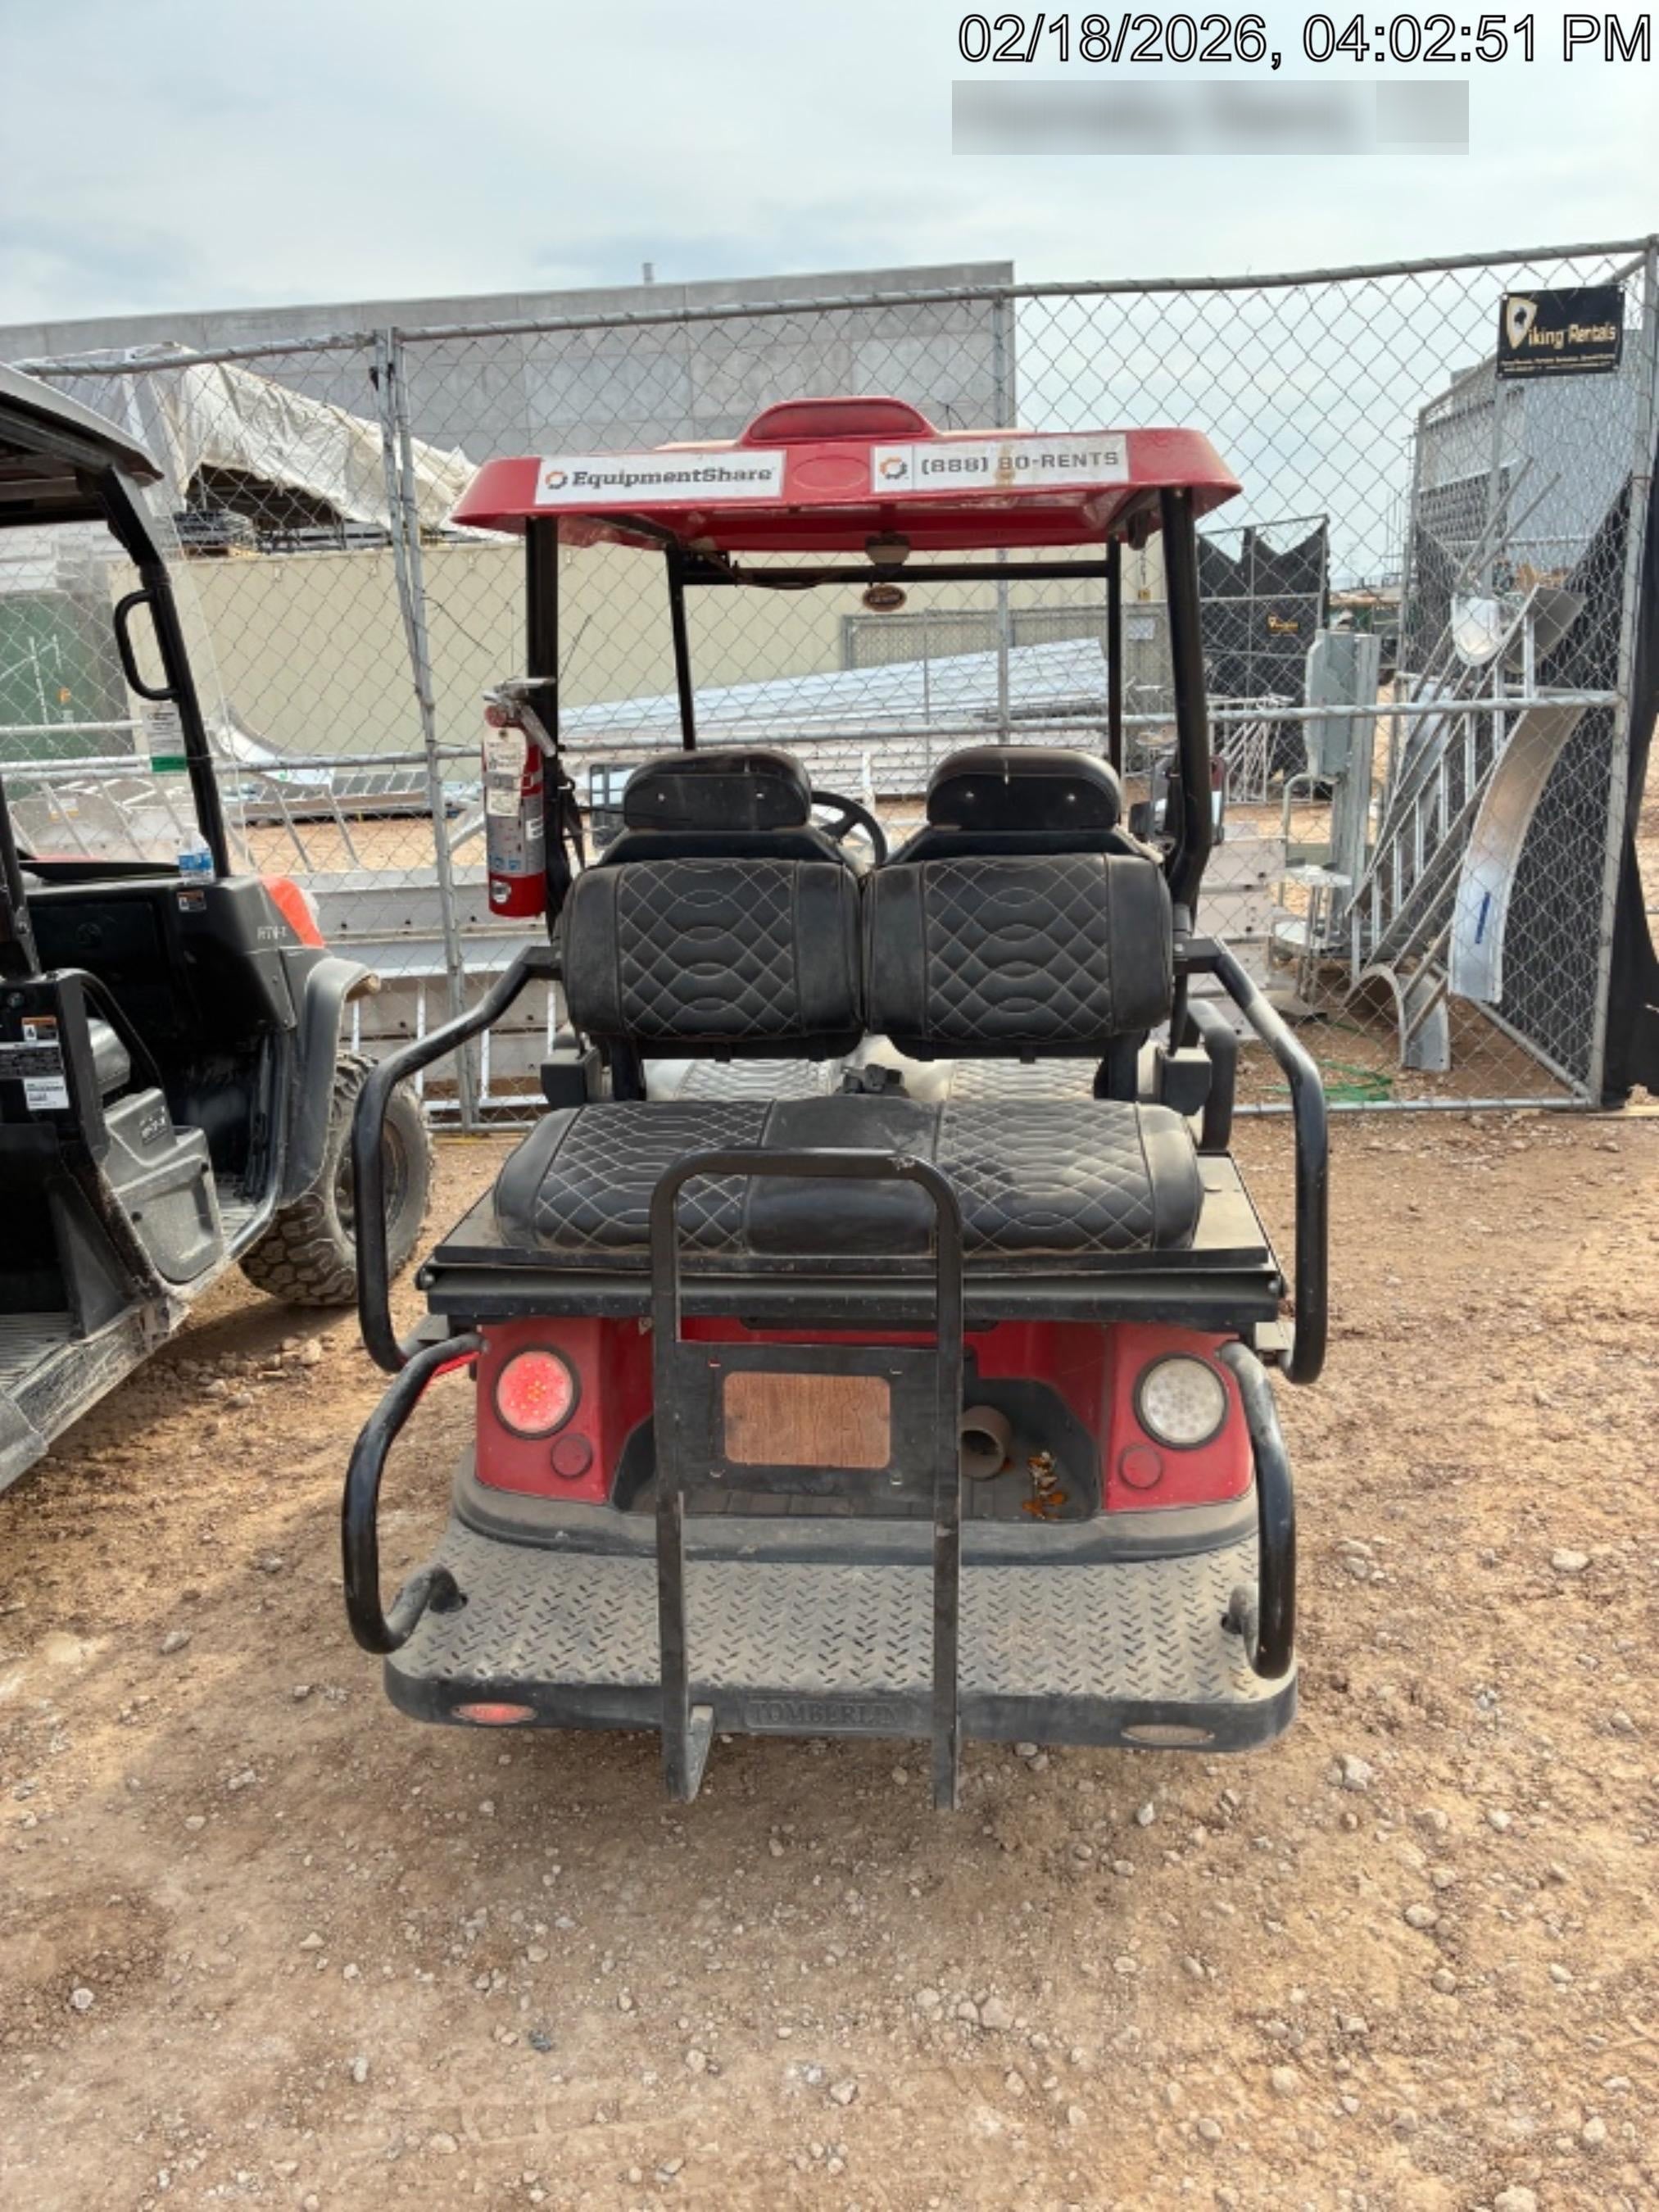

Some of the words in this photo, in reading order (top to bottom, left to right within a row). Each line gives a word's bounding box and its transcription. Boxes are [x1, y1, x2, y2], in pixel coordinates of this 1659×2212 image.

[1569, 322, 1616, 343] Rentals
[921, 456, 989, 475] (888)
[572, 468, 773, 489] EquipmentShare
